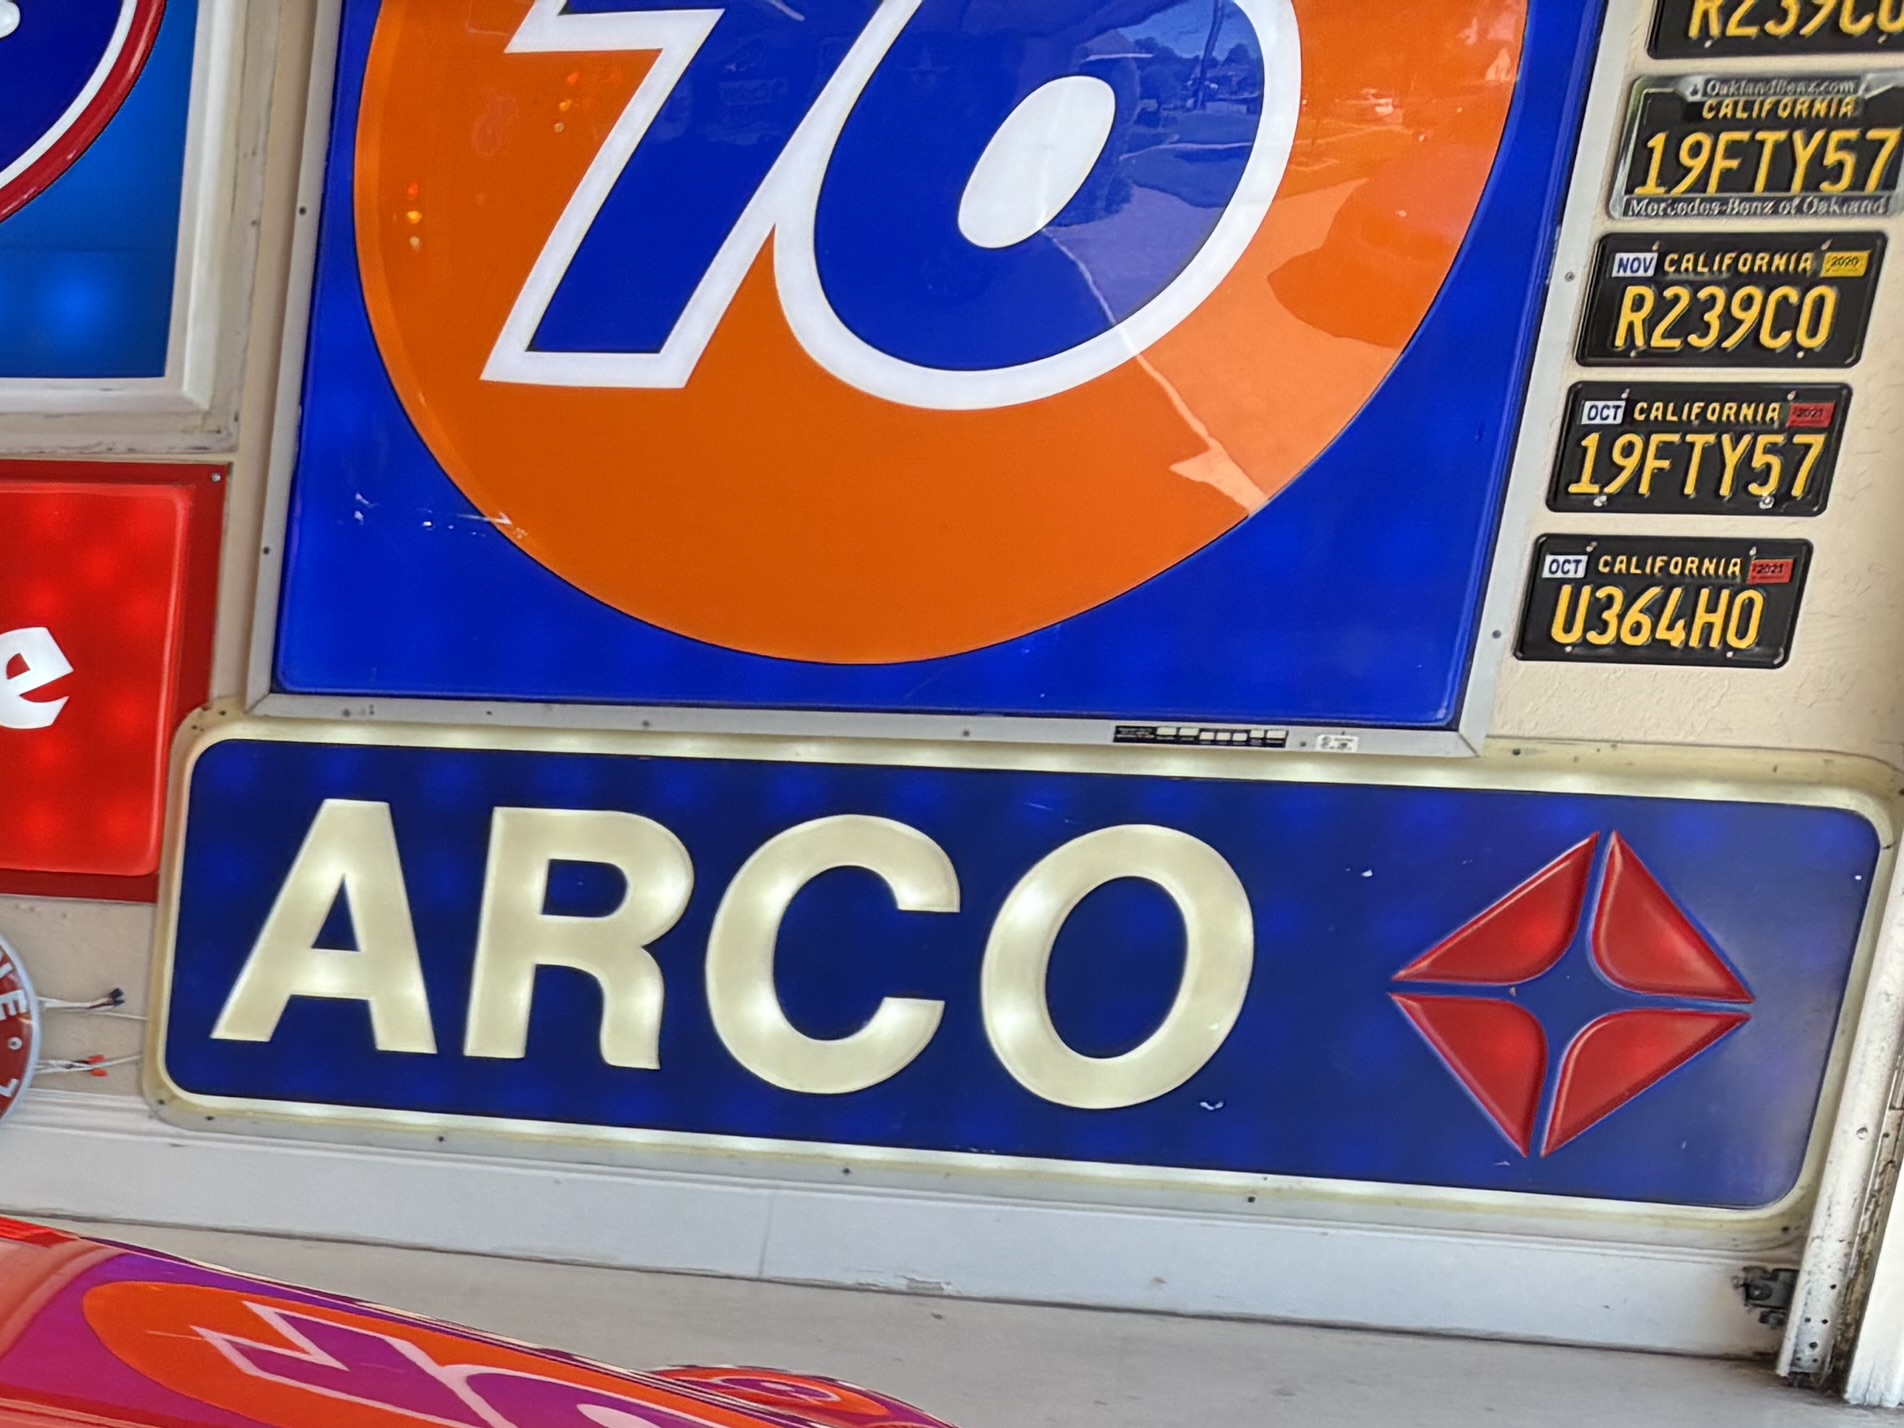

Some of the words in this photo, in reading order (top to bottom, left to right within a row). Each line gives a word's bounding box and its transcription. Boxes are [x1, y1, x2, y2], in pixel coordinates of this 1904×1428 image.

[1702, 96, 1857, 120] CALIFORNIA
[1633, 127, 1903, 195] 19FTY57
[480, 0, 1302, 411] 76
[1804, 197, 1886, 215] Oakland
[1616, 255, 1652, 276] NOV
[1664, 251, 1813, 273] CALIFORNIA
[1587, 405, 1621, 422] OCT
[1633, 401, 1782, 423] CALIFORNIA
[1568, 432, 1827, 498] 19FTY57
[1548, 558, 1582, 575] OCT
[1598, 555, 1742, 576] CALIFORNIA
[210, 798, 1255, 1109] ARCO
